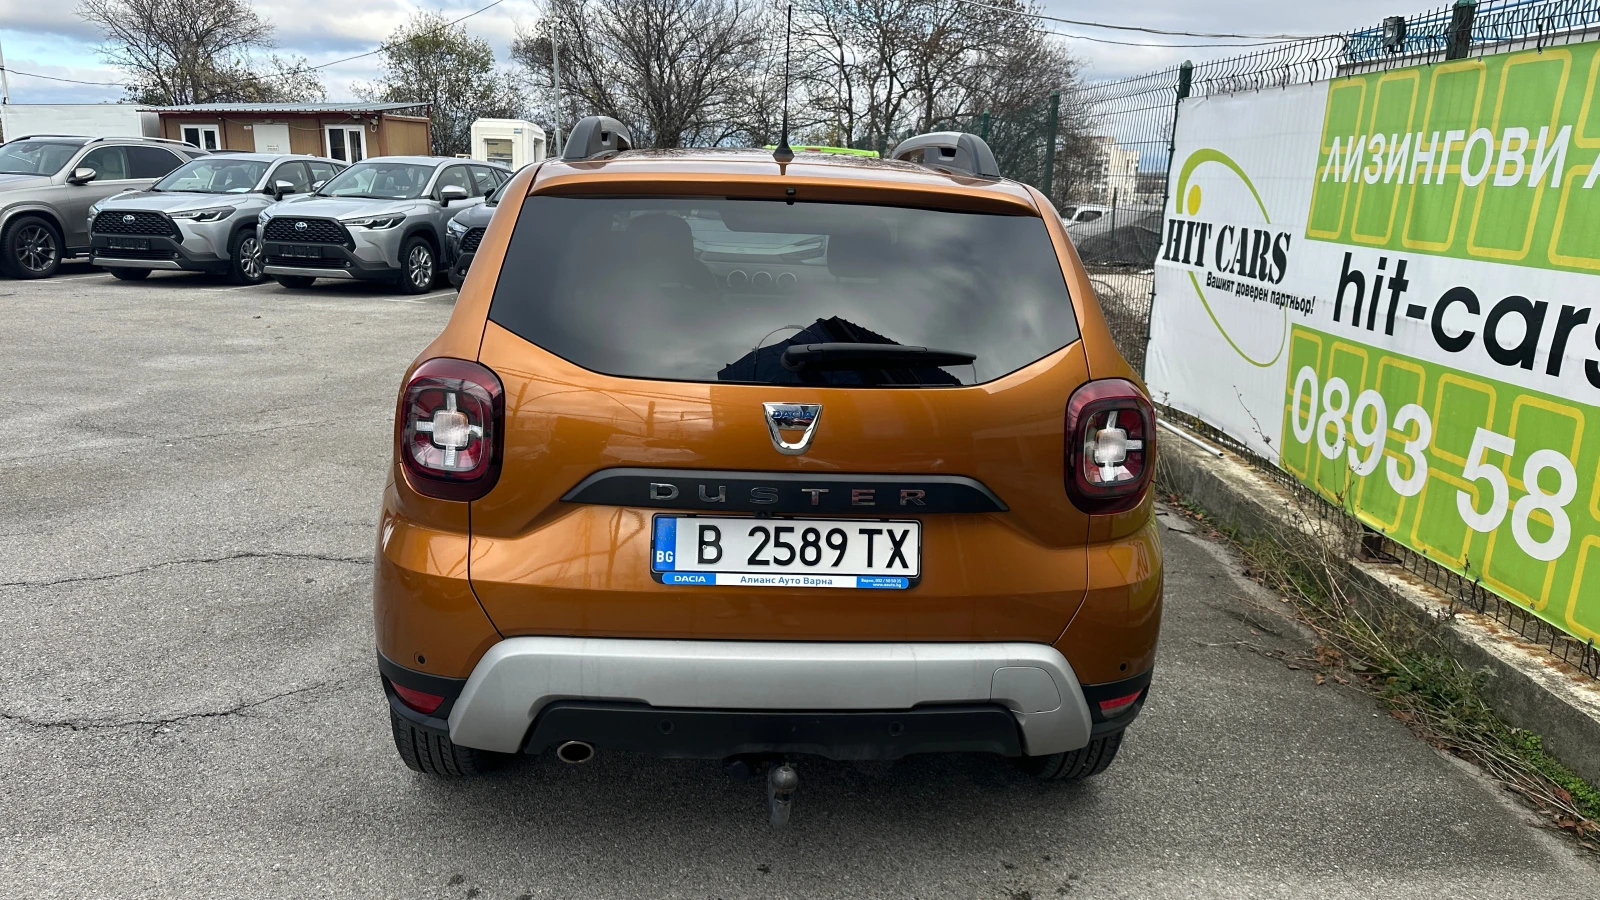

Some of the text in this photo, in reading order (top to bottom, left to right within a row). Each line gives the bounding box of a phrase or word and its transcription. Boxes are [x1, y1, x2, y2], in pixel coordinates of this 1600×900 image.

[1322, 125, 1571, 188] ЛИЗИНГОВИ
[1162, 218, 1292, 285] HIT CARS
[1206, 271, 1316, 317] Вашият доверен партньор!
[772, 410, 813, 420] DACIA
[1292, 365, 1577, 562] 0893 58
[650, 482, 926, 507] DUSTER
[656, 524, 910, 569] BG B 2589 TX
[674, 575, 706, 583] DACIA
[740, 575, 833, 587] Алианс Ауто Варна
